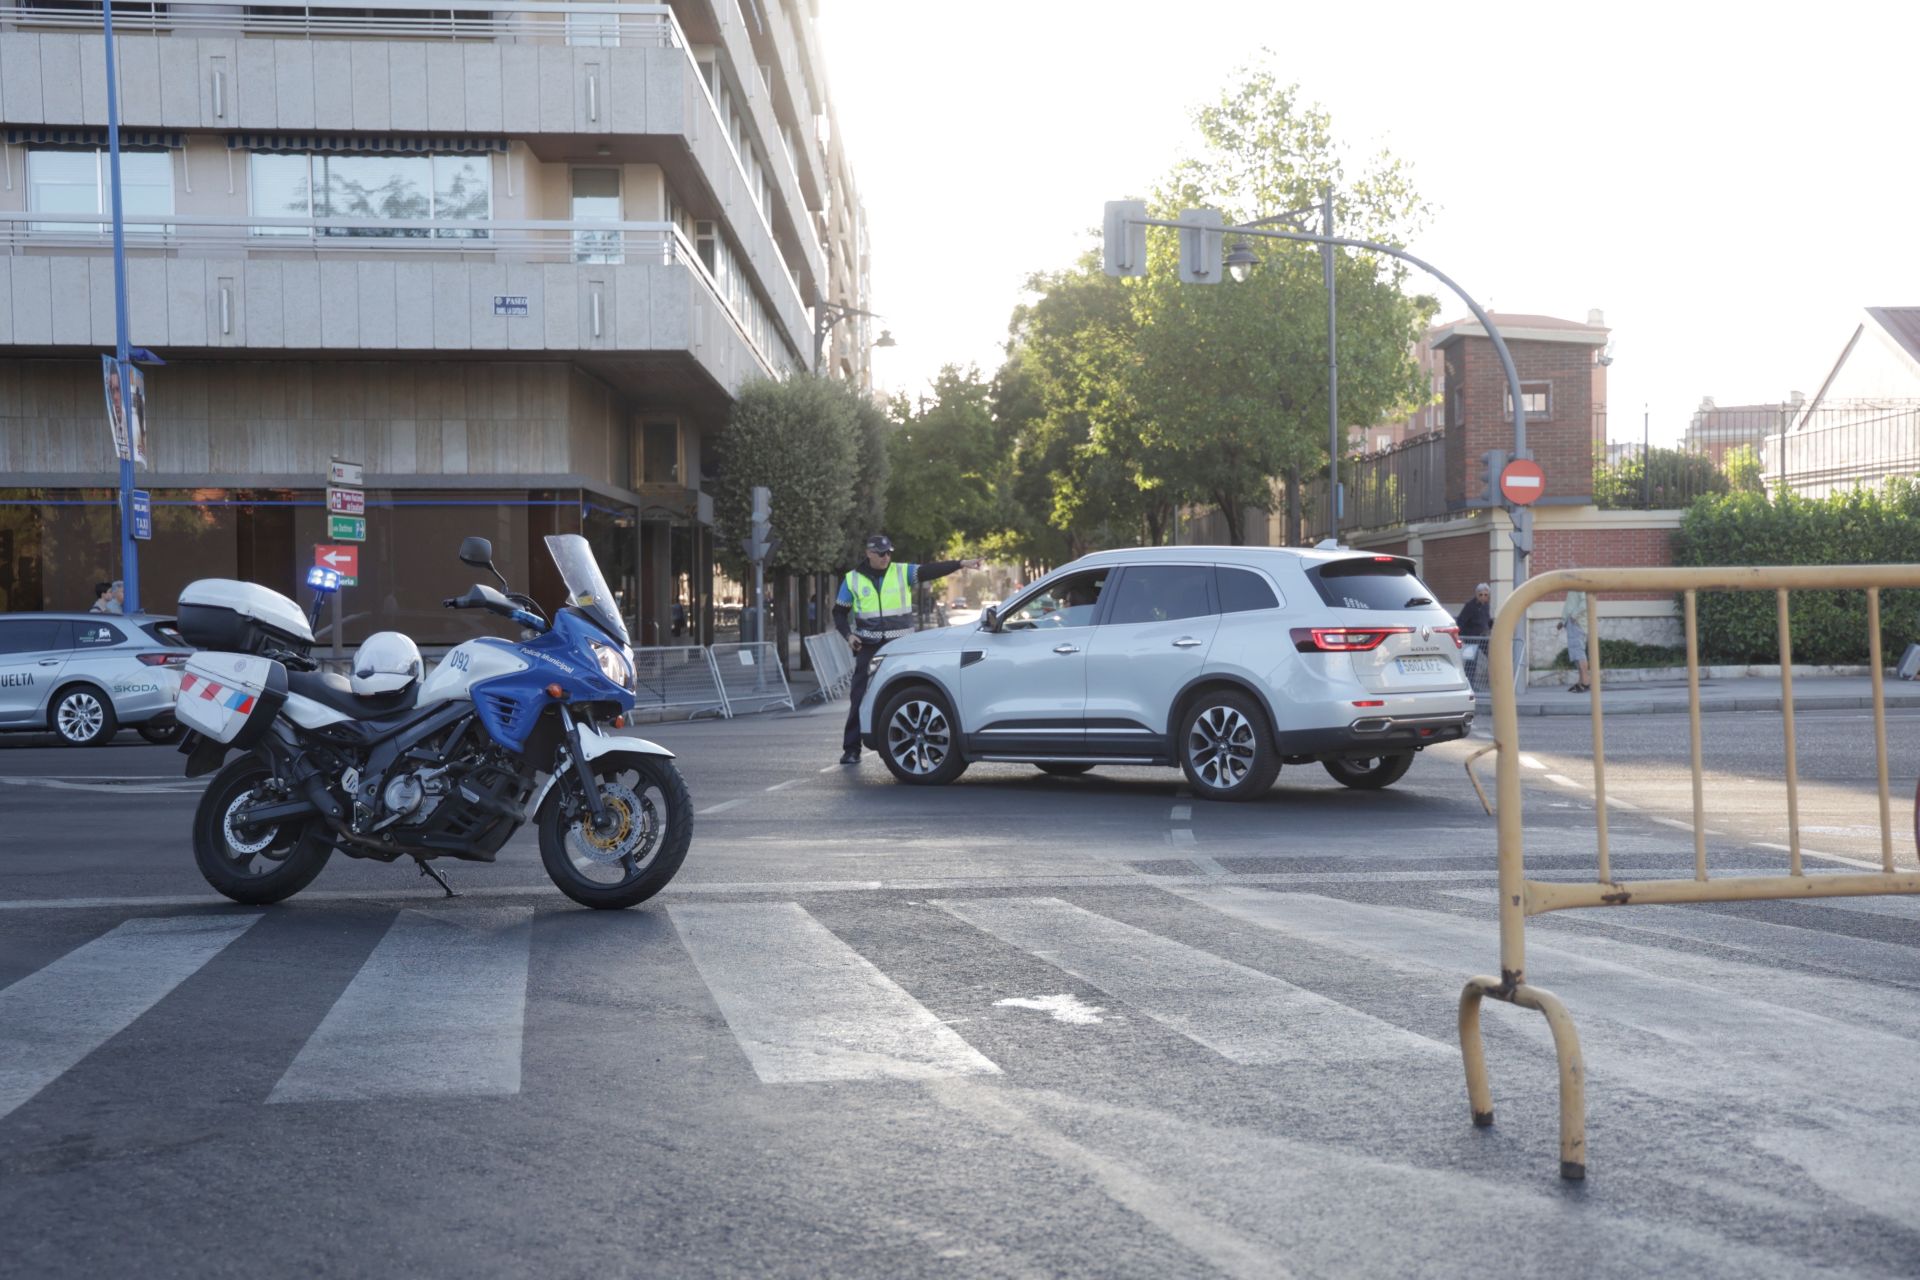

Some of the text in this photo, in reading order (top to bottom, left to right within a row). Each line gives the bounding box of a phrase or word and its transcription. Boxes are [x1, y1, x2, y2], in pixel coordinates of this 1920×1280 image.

[506, 297, 528, 305] PASEO
[136, 518, 149, 529] TAXI
[541, 653, 575, 674] Municipal
